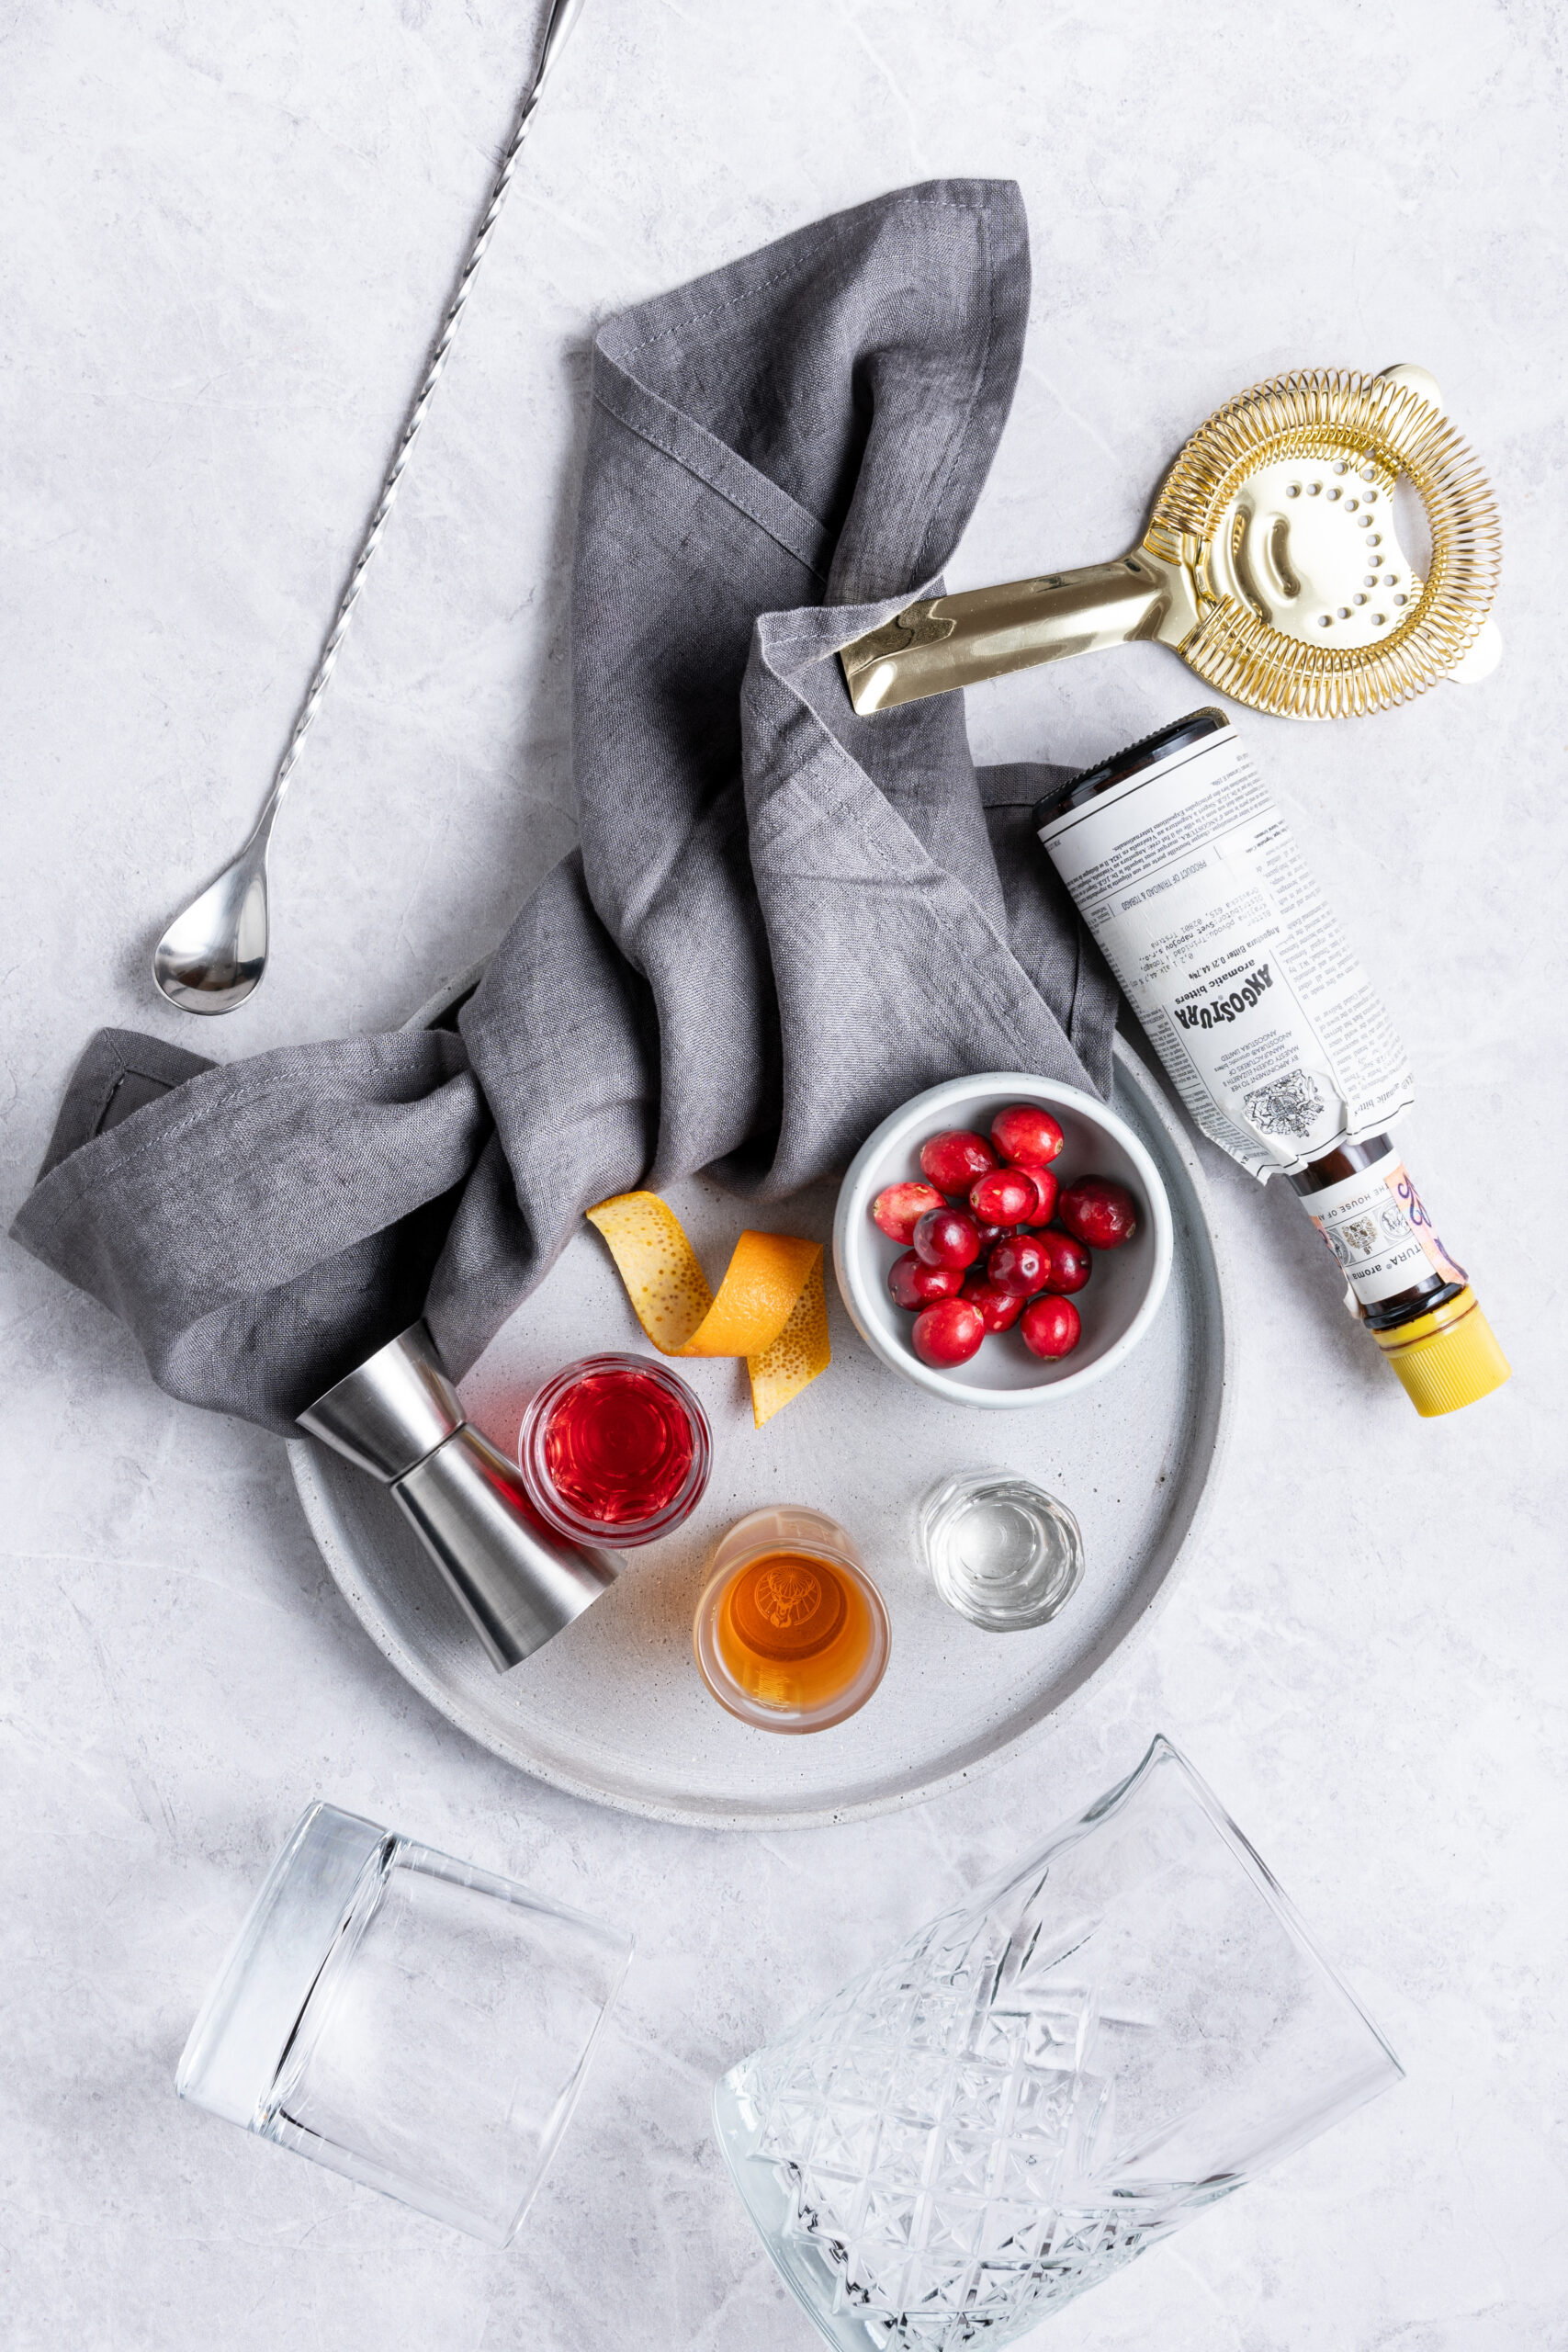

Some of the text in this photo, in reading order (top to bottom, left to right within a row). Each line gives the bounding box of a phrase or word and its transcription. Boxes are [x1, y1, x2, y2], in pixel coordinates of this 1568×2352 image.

[1184, 793, 1213, 812] principales
[1198, 801, 1216, 815] Siegert
[1153, 809, 1185, 830] Expositions
[1205, 808, 1218, 819] nom
[1165, 815, 1193, 831] Angostura
[1183, 821, 1195, 831] ville
[1112, 827, 1154, 852] Internationales.
[1161, 834, 1171, 843] fut
[1190, 830, 1211, 843] chaque
[1156, 837, 1179, 854] marque
[1167, 841, 1191, 856] bouteille
[1120, 848, 1146, 865] Angostura
[1144, 849, 1156, 861] sous
[1151, 853, 1167, 865] porte
[1123, 857, 1145, 872] laquelle
[1132, 867, 1142, 876] son
[1142, 862, 1152, 870] sur
[1111, 873, 1133, 887] étiquette
[1121, 860, 1207, 910] PRODUCT OF TRINIDAD & TOBAGO
[1180, 918, 1202, 933] 02801
[1246, 926, 1280, 948] Angostura
[1226, 945, 1247, 960] Bitter
[1175, 959, 1255, 1005] aromatic bitters
[1175, 965, 1272, 1029] ANGOSTURA
[1220, 1030, 1277, 1062] ANGOSTURA LIMITED
[1275, 1045, 1300, 1062] MAJESTY
[1228, 1052, 1251, 1066] aromatic
[1228, 1044, 1285, 1077] MANUFACTURERS OF
[1252, 1058, 1274, 1073] QUEEN
[1213, 1062, 1230, 1072] bitters
[1230, 1054, 1300, 1092] BY APPOINTMENT TO HER
[1226, 1069, 1253, 1085] ELIZABETH
[1338, 1194, 1371, 1214] HOUSE
[1327, 1209, 1337, 1219] OF
